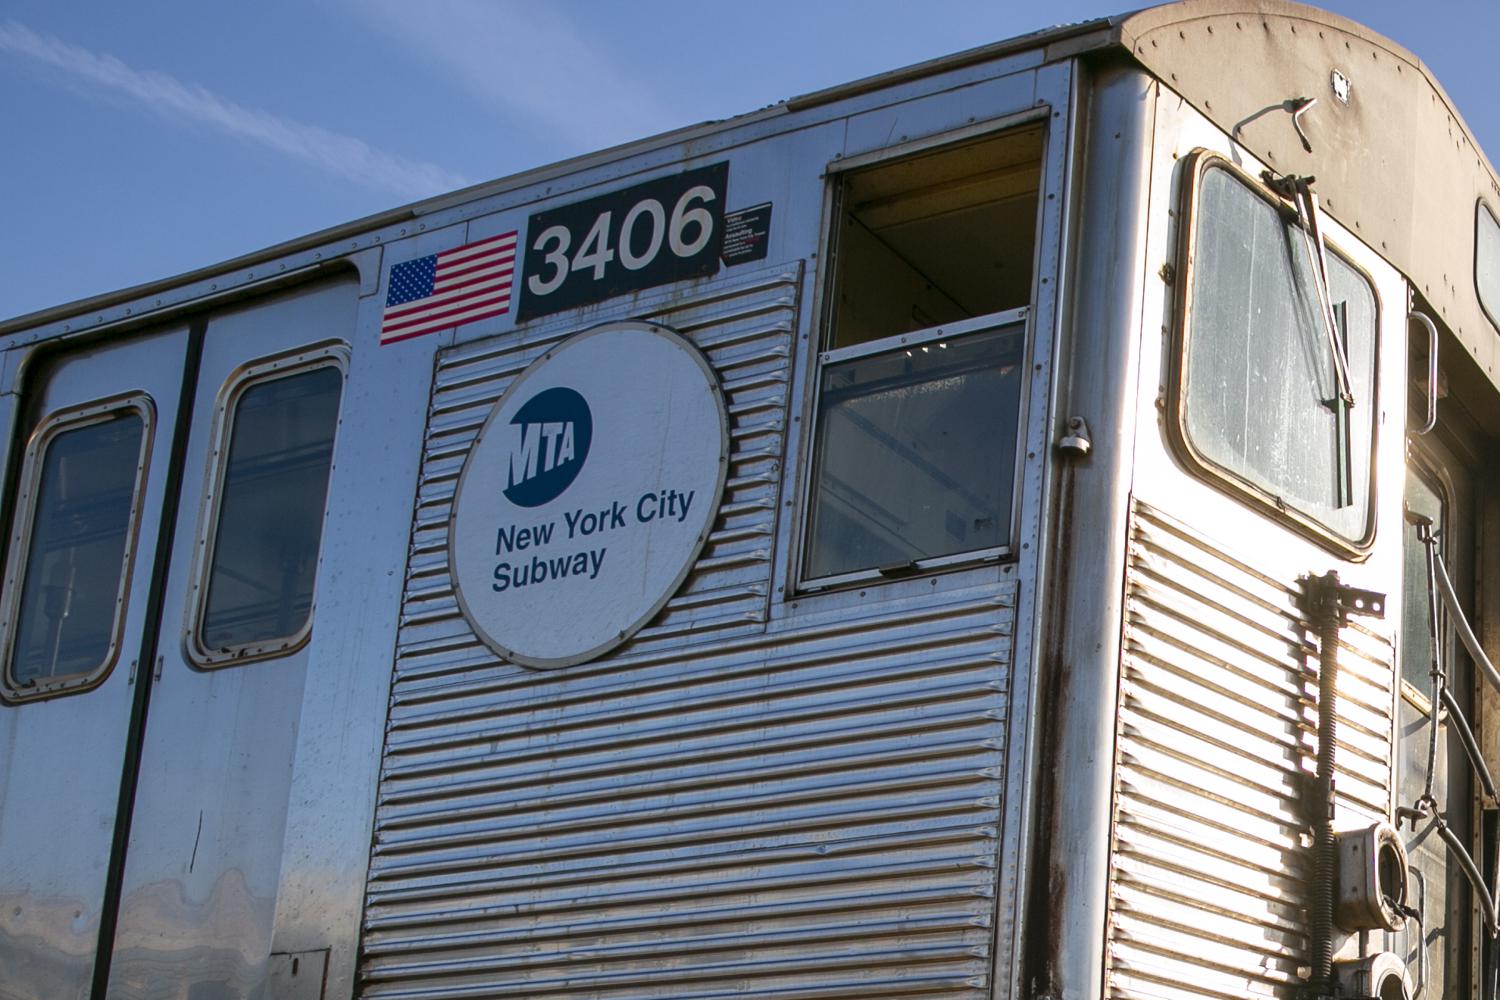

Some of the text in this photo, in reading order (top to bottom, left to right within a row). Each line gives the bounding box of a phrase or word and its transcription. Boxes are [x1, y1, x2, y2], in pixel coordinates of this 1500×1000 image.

[528, 185, 716, 296] 3406
[507, 421, 575, 489] MTA
[496, 489, 695, 555] New York City
[492, 548, 607, 592] Subway
